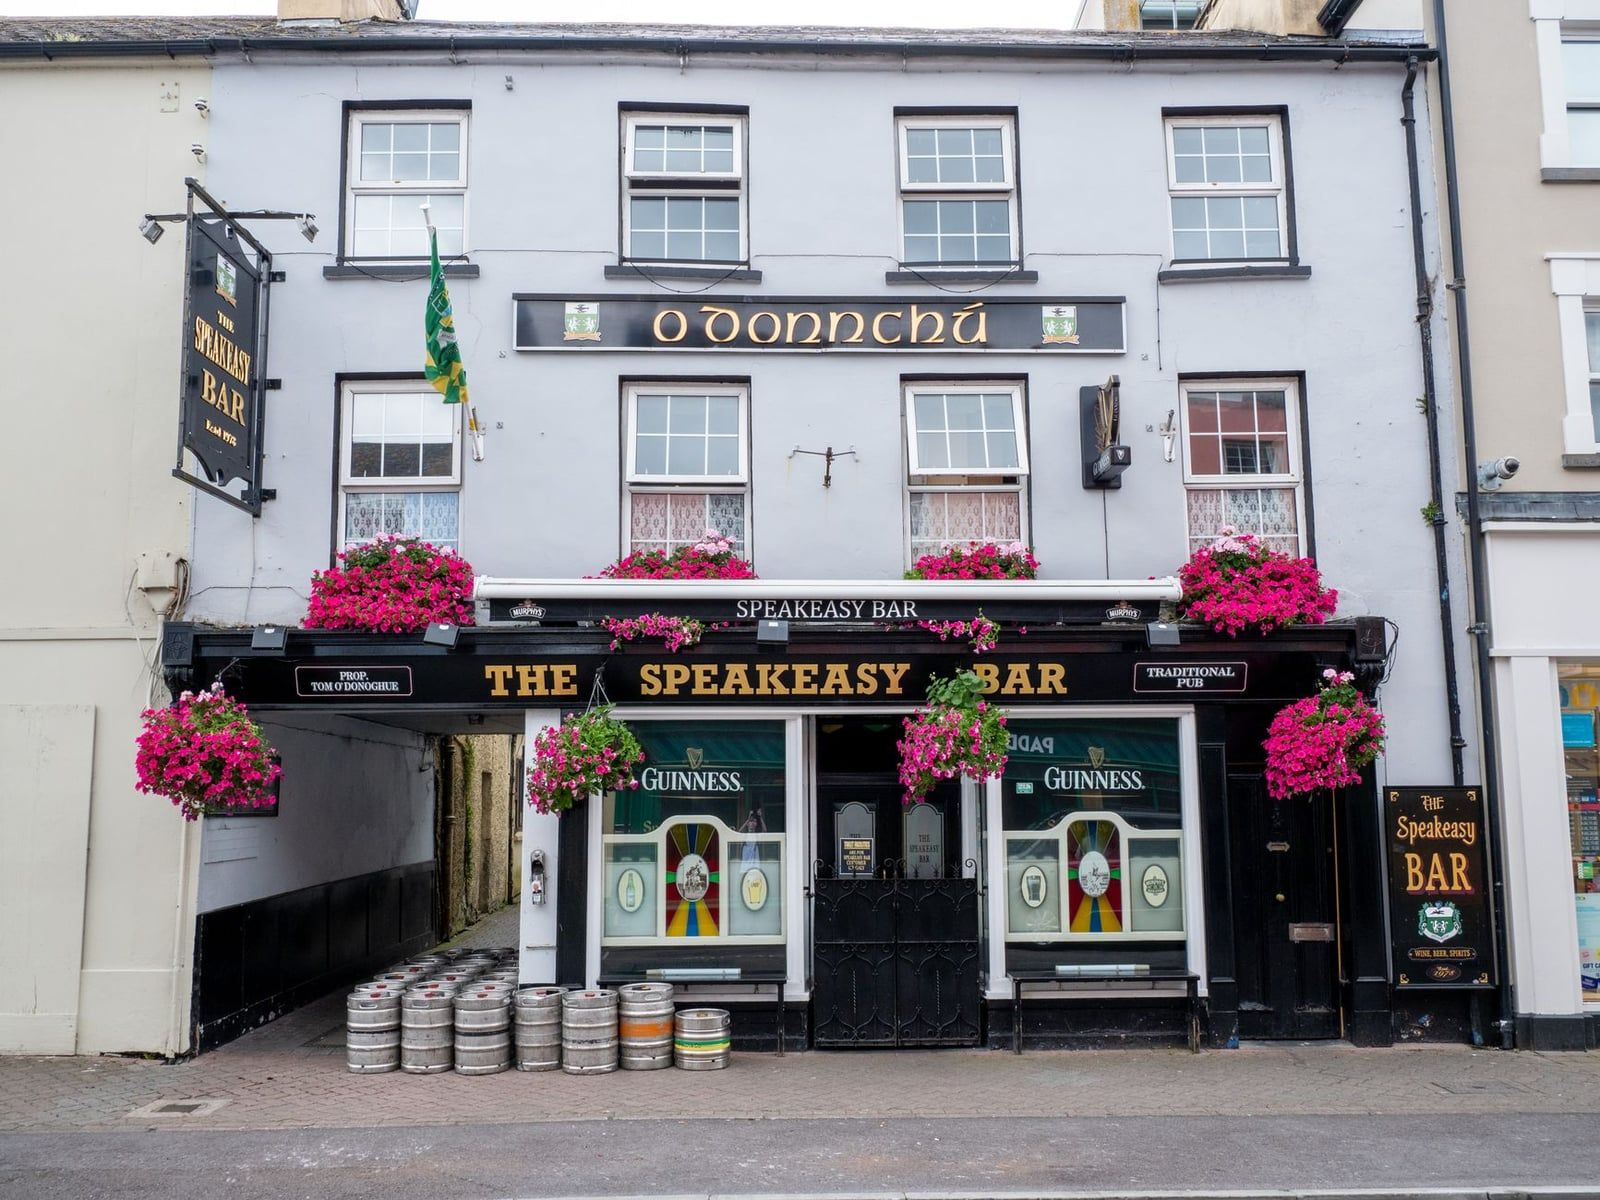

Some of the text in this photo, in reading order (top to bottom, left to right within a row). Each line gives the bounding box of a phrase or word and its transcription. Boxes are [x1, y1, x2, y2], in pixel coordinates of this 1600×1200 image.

[218, 311, 235, 333] THE
[195, 316, 251, 386] SPEAKEASY
[201, 368, 246, 426] BAR
[737, 600, 918, 618] SPEAKEASY BAR
[340, 671, 369, 680] PROP.
[484, 663, 1067, 696] THE SPEAKEASY BAR
[1146, 667, 1235, 677] TRADITIONAL
[1176, 678, 1204, 688] PUB
[311, 682, 333, 691] TOM
[641, 767, 741, 792] GUINNESS
[1044, 766, 1142, 790] GUINNESS
[1421, 795, 1444, 811] THE
[1397, 815, 1475, 845] Speakeasy
[1405, 852, 1472, 892] BAR
[1449, 949, 1471, 958] SPIRITS
